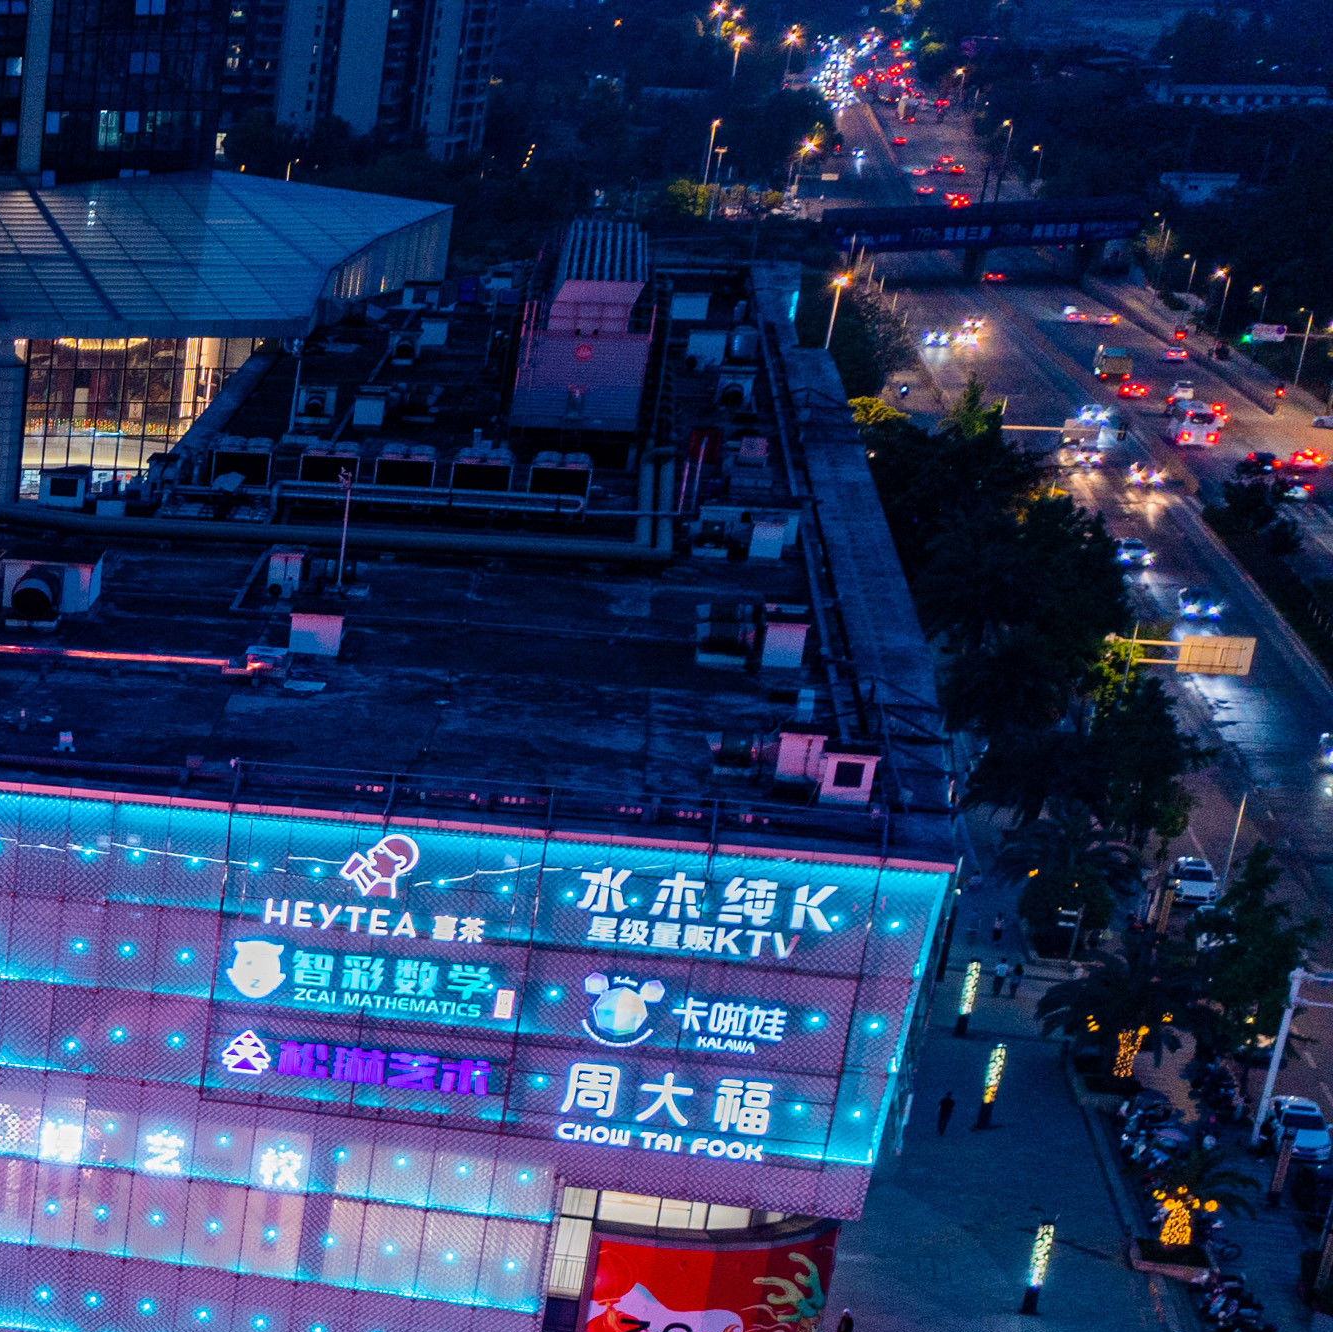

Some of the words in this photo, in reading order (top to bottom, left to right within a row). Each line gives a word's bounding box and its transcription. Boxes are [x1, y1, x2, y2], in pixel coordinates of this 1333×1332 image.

[264, 898, 416, 939] HEYTEA
[432, 915, 485, 943] 喜茶
[577, 867, 839, 932] 水木纯K
[587, 916, 801, 959] 星级量贩KTV
[293, 950, 491, 1000] 智彩数学
[294, 987, 336, 1005] ZCAI
[343, 993, 481, 1018] MATHEMATICS
[673, 997, 787, 1041] 卡啦娃
[697, 1036, 755, 1053] KALAWA
[277, 1041, 492, 1096] 松琳艺术
[560, 1063, 773, 1135] 周大福
[557, 1122, 630, 1147] CHOW
[640, 1131, 682, 1153] TAI
[690, 1138, 763, 1162] FOOK
